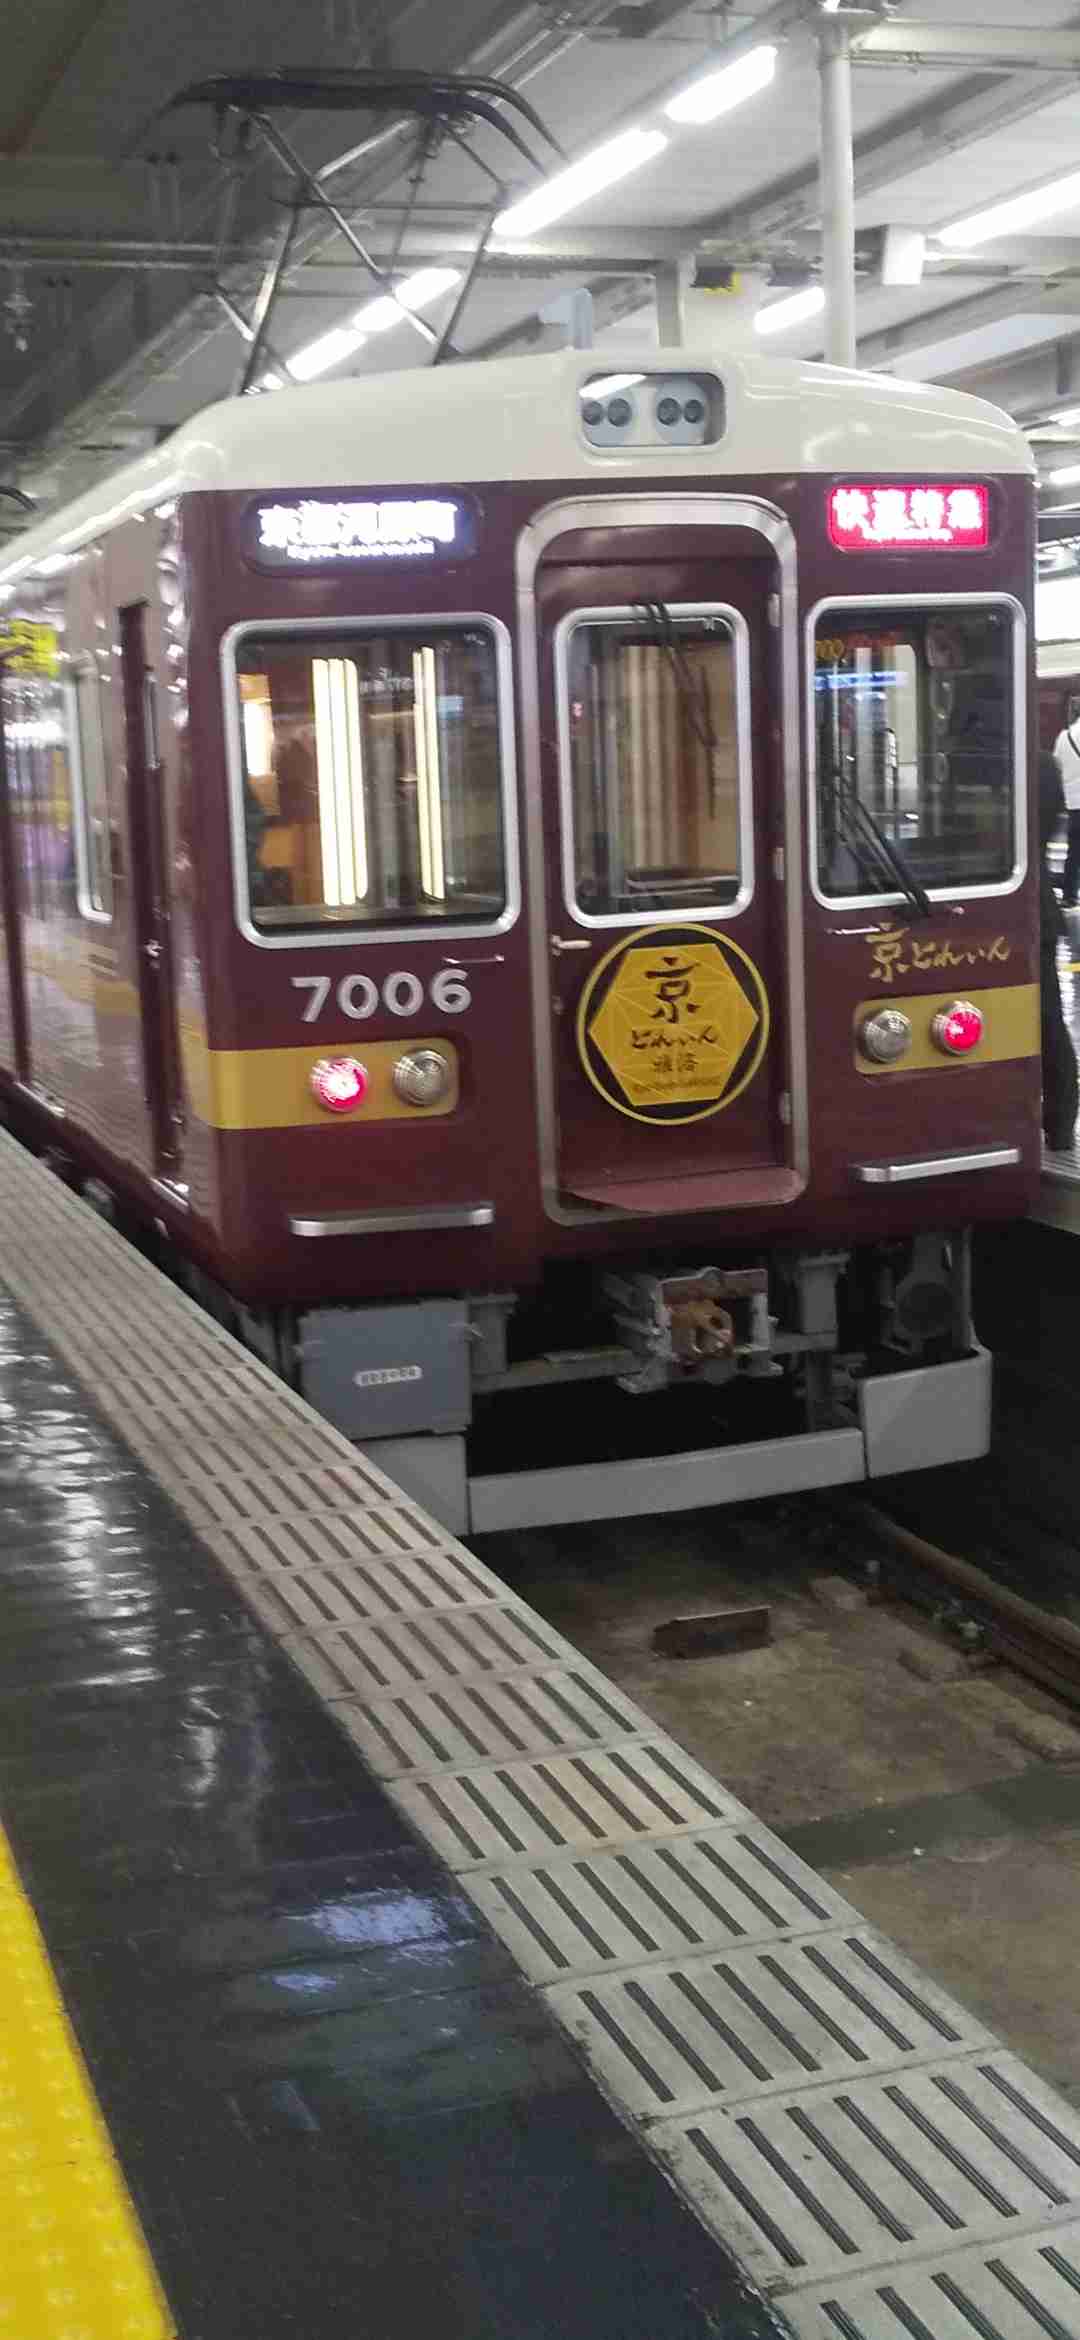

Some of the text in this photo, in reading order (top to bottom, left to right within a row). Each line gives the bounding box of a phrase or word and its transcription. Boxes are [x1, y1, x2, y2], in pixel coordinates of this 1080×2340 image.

[865, 921, 1010, 983] 京とれいん
[290, 968, 472, 1022] 7006
[644, 955, 702, 1024] 京
[631, 1025, 718, 1049] とれいん
